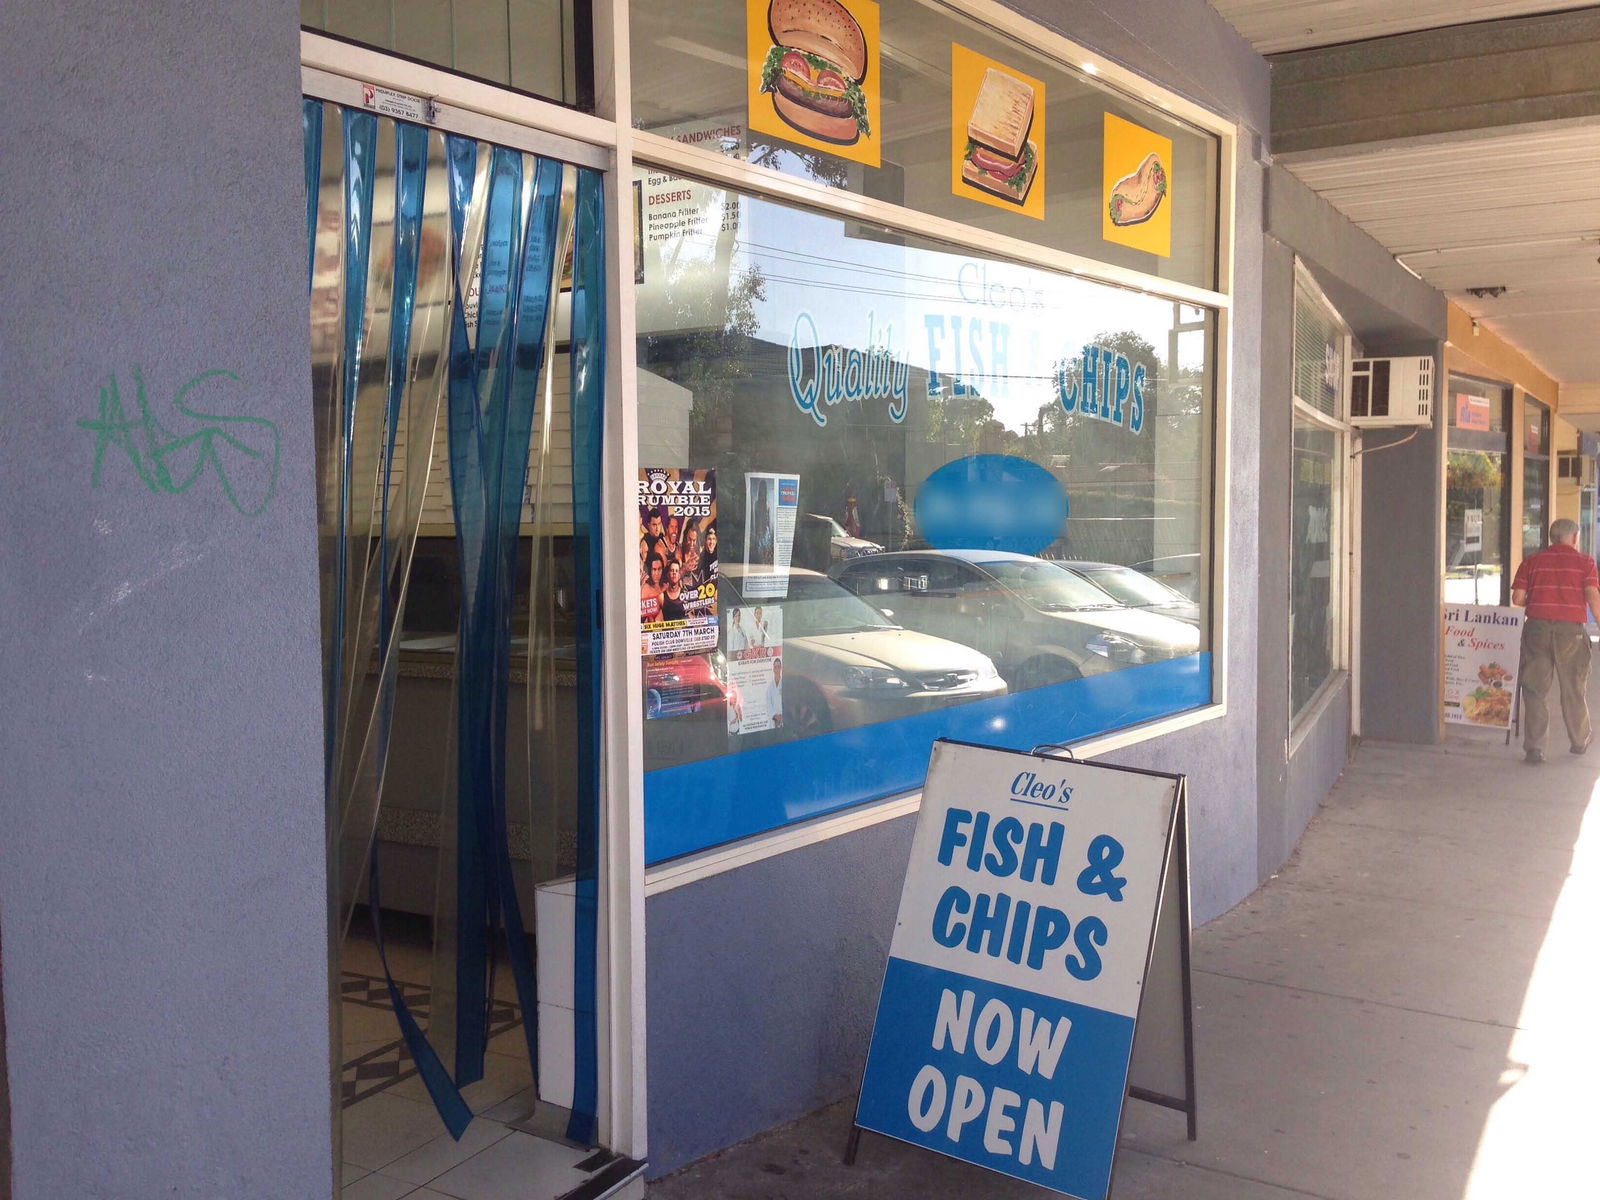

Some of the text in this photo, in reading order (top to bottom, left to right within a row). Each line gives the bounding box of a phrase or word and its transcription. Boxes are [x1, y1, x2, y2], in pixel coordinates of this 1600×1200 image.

[676, 125, 742, 143] SANDWICHES
[648, 176, 661, 186] Egg
[648, 189, 692, 206] DESSERTS
[648, 211, 677, 221] Banana
[648, 220, 686, 231] Pineapple
[648, 230, 681, 241] Pumpkin
[788, 308, 910, 428] Quality
[923, 313, 1011, 400] FISH
[1058, 344, 1146, 434] CHIPS
[638, 480, 712, 494] ROYAL
[638, 494, 711, 506] RUMBLE
[674, 506, 711, 517] 2015
[680, 583, 716, 601] OVER 20
[683, 597, 715, 610] WRESTLERS
[1464, 610, 1518, 626] Lankan
[652, 632, 680, 640] SATURDAY
[693, 627, 715, 635] MARCH
[1445, 625, 1475, 638] Food
[1457, 637, 1505, 651] & Spices
[1010, 771, 1074, 803] Cleo's
[937, 807, 1127, 902] FISH &
[932, 886, 1108, 982] CHIPS
[931, 988, 1073, 1080] NOW
[908, 1064, 1065, 1171] OPEN
